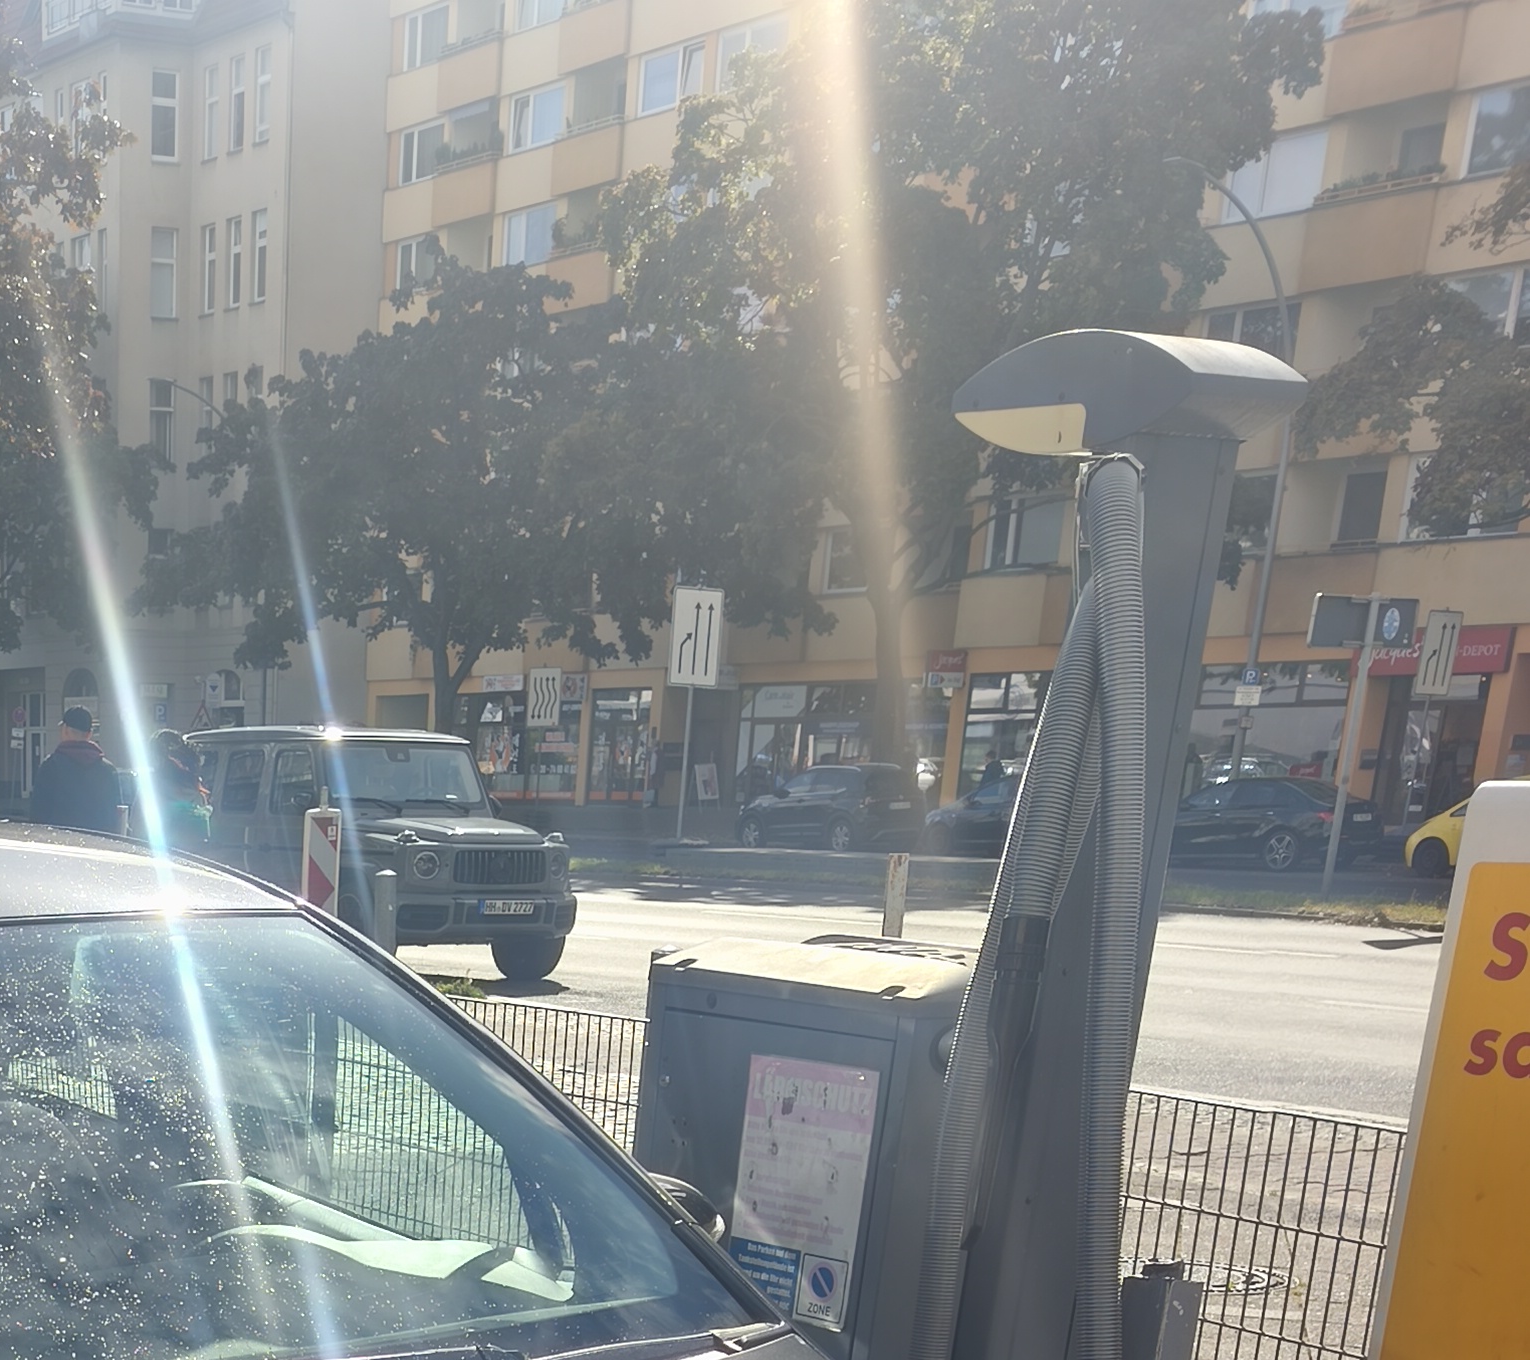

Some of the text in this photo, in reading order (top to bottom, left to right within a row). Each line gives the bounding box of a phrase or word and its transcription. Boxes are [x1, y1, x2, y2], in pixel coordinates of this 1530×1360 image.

[1456, 644, 1502, 657] -DEPOT
[485, 901, 496, 912] HH
[513, 901, 534, 912] 2727
[758, 1245, 775, 1256] Parken
[807, 1302, 831, 1317] ZONE
